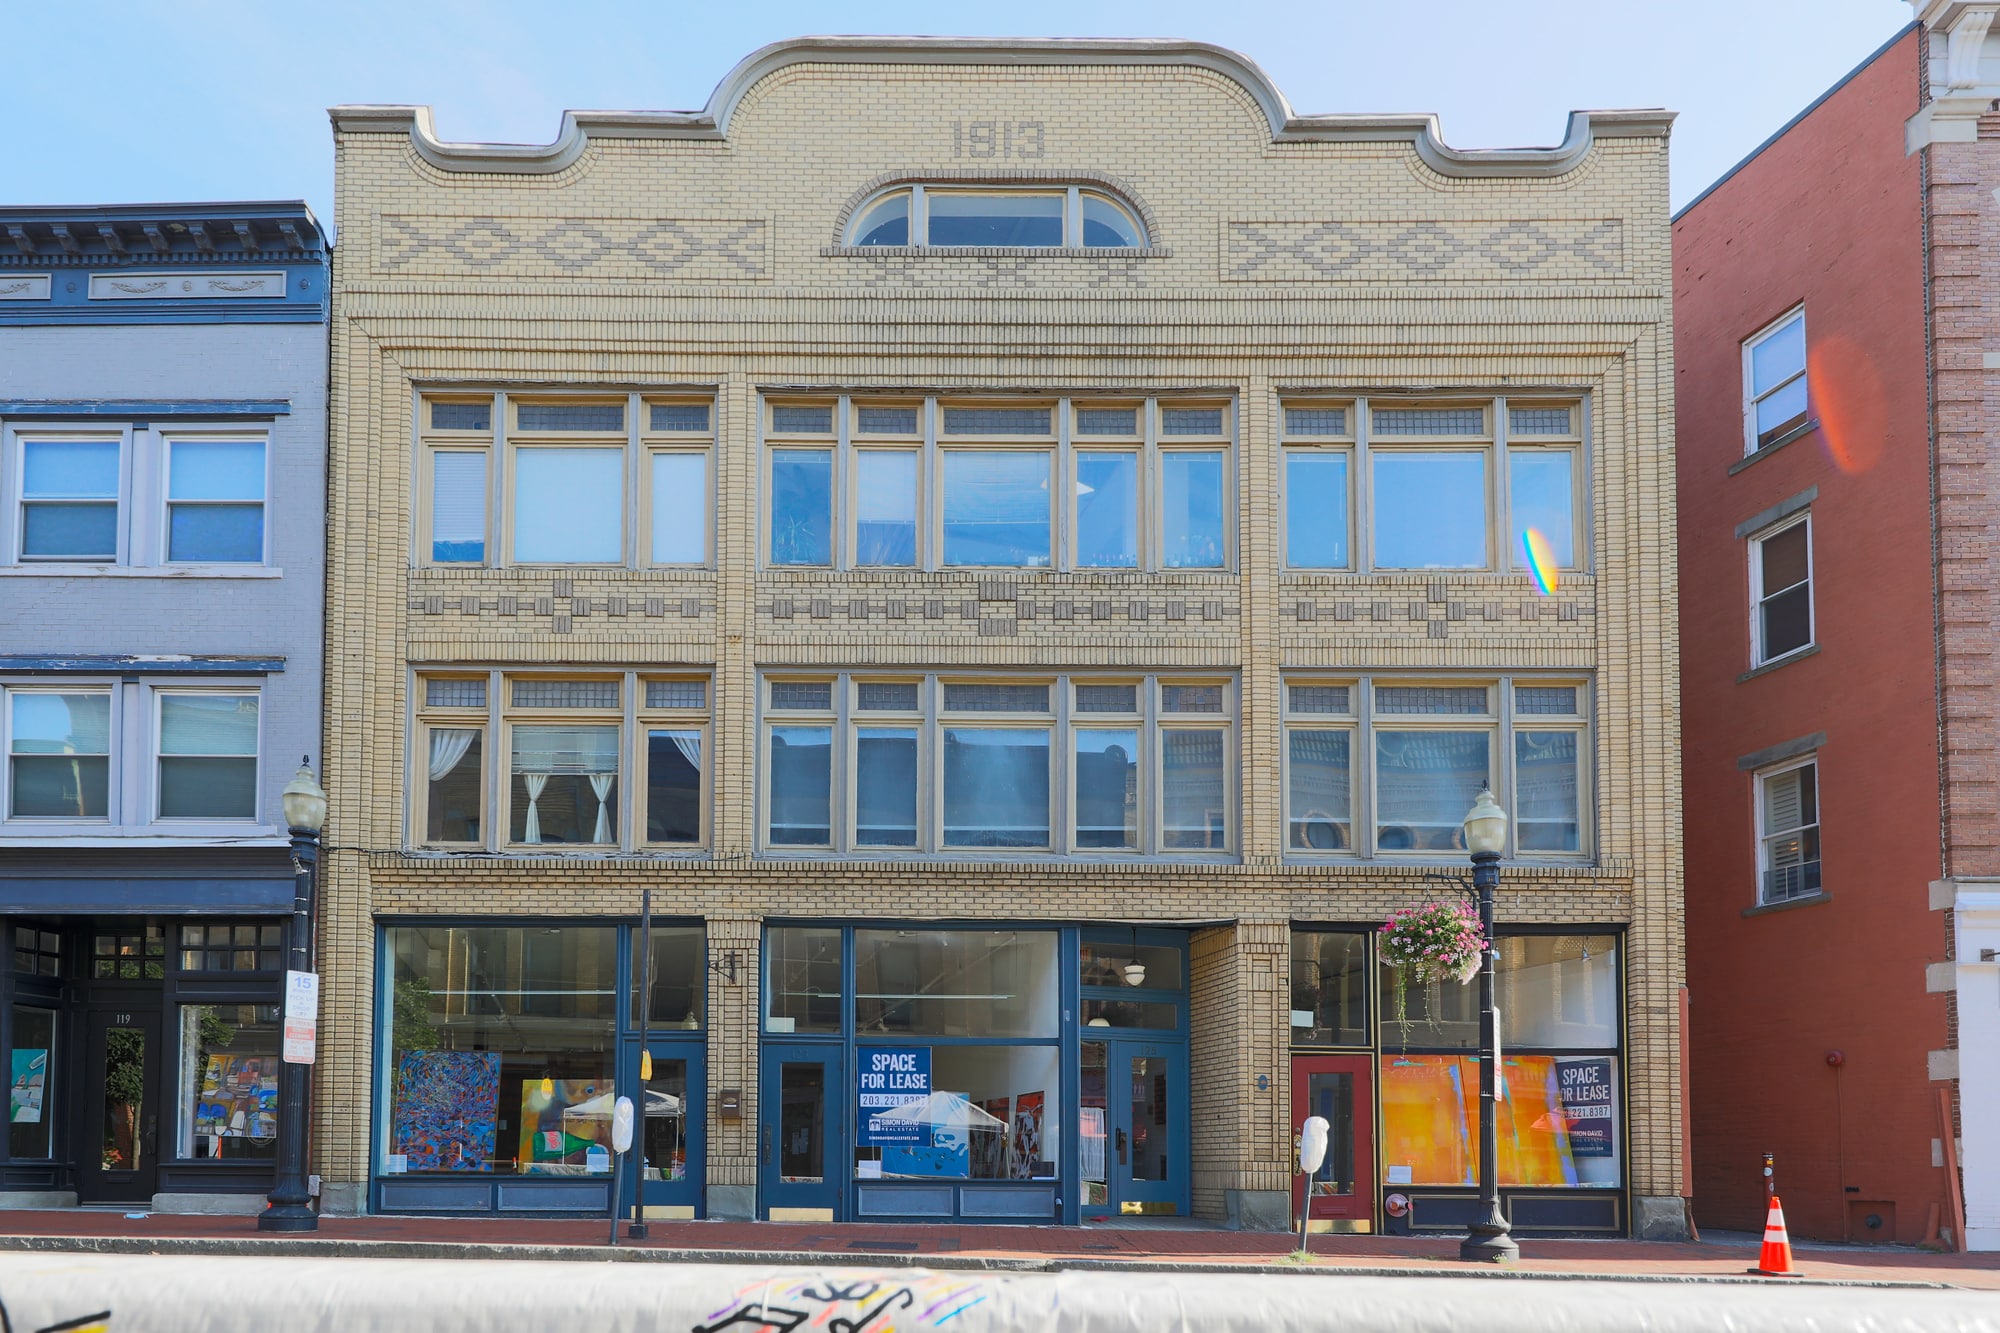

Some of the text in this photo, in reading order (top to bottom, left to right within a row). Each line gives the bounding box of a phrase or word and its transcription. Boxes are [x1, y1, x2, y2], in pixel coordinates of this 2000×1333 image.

[953, 121, 1044, 158] 1913
[294, 976, 312, 989] 15
[117, 1014, 130, 1024] 119
[872, 1054, 917, 1071] SPACE
[861, 1073, 928, 1089] FOR LEASE
[1562, 1066, 1600, 1085] SPACE
[1560, 1084, 1610, 1101] OR LEASE
[1564, 1106, 1608, 1118] 3.221.8387
